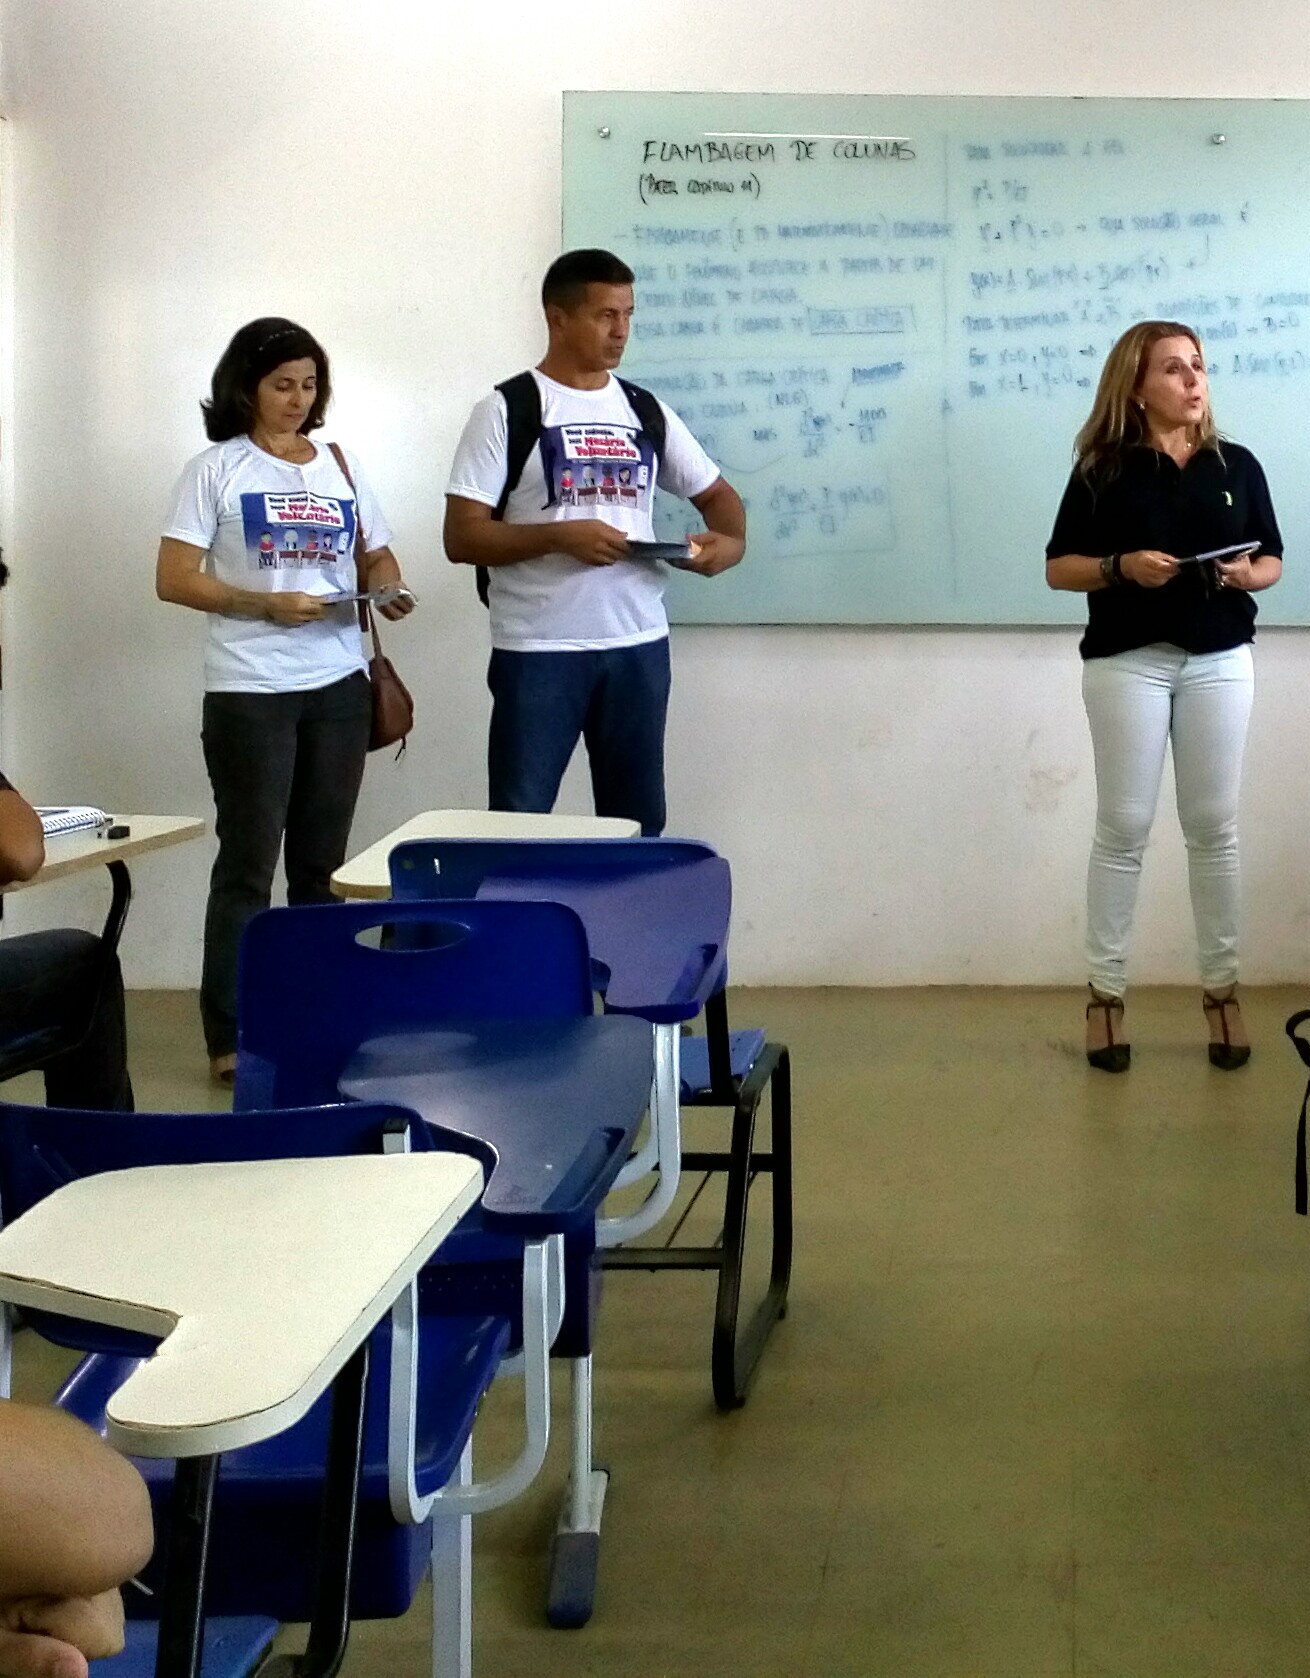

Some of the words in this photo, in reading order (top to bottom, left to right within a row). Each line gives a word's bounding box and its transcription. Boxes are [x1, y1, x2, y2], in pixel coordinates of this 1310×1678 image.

[643, 140, 776, 164] FLAMBAGEM
[790, 140, 815, 162] DE
[832, 141, 917, 162] COLUNAS
